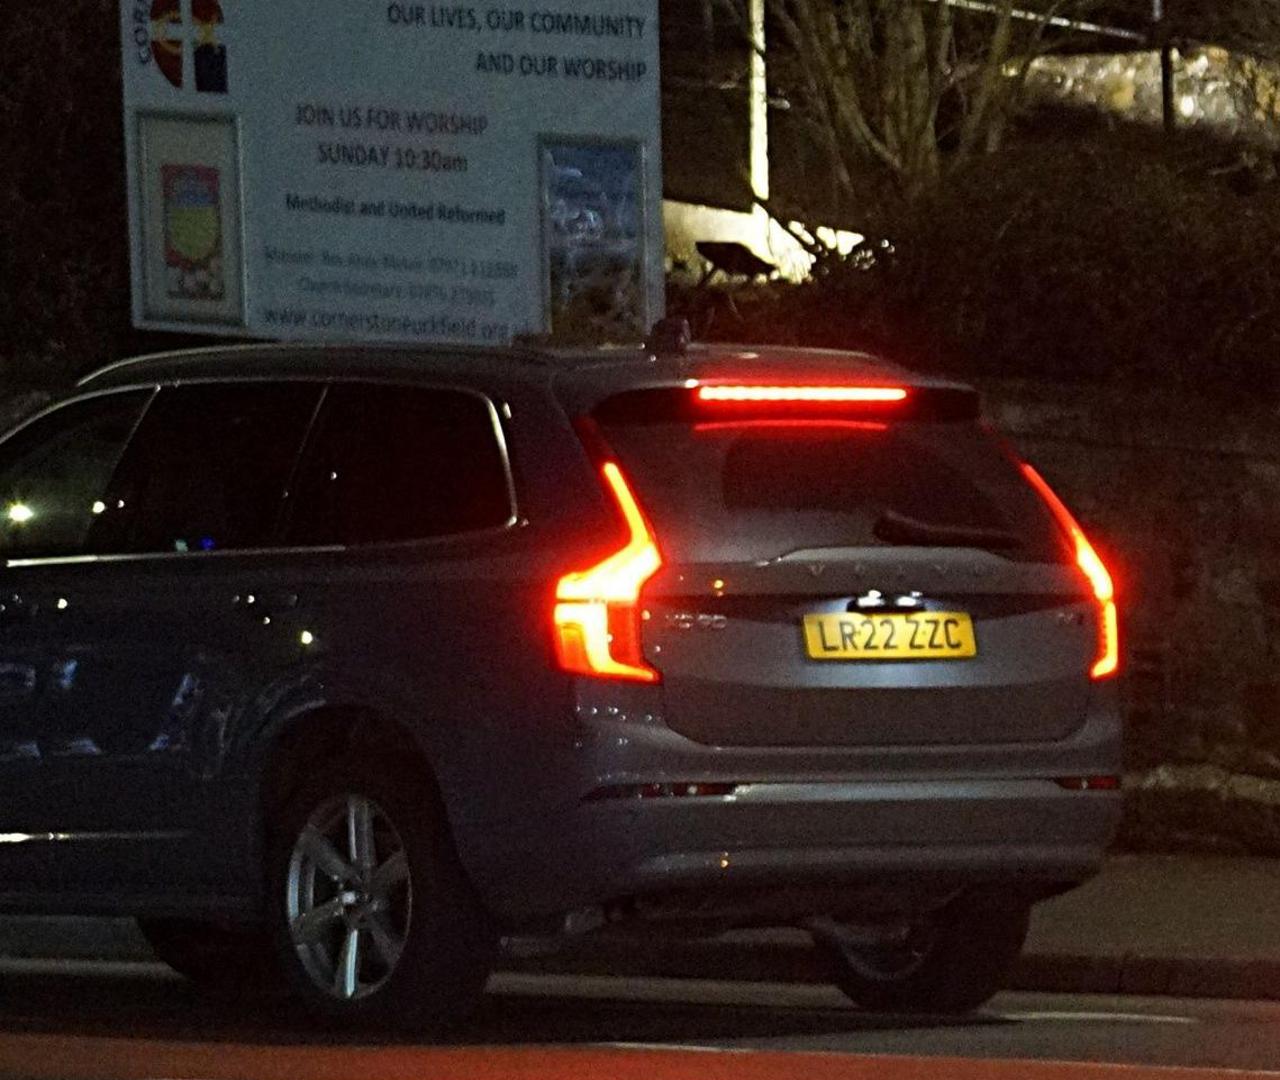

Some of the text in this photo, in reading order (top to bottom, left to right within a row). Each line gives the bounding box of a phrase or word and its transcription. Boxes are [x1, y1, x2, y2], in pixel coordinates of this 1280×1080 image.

[133, 0, 151, 65] COR
[387, 3, 646, 38] OUR LIVES, OUR COMMUNITY
[476, 53, 647, 82] AND OUR WORSHIP
[296, 104, 489, 135] JOIN US FOR WORSHIP
[318, 142, 468, 172] SUNDAY 10:30am
[286, 194, 506, 225] Methodist and United Reformed
[818, 618, 962, 652] LR22 ZZC
